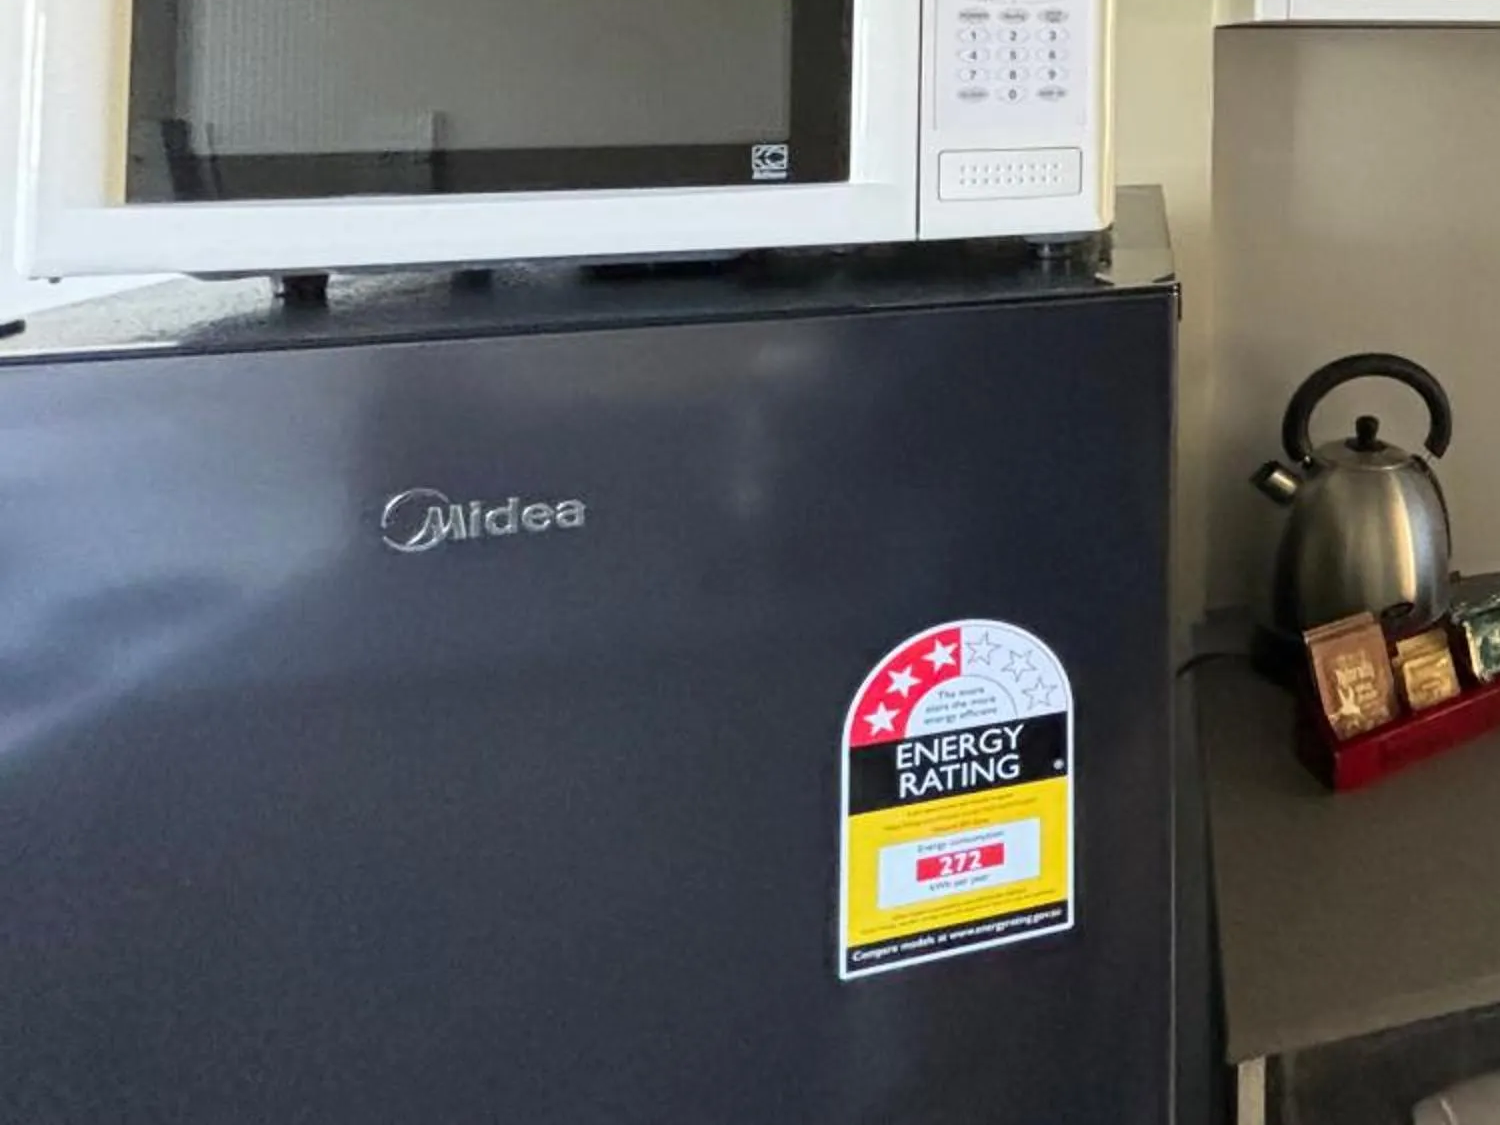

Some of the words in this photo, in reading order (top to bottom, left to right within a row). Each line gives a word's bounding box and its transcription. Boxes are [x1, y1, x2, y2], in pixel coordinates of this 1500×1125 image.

[1009, 30, 1017, 42] 2
[1048, 29, 1057, 42] 3
[969, 50, 977, 61] 4
[969, 69, 977, 81] 7
[1008, 88, 1017, 100] 0
[381, 487, 586, 552] Midea
[938, 690, 956, 700] The
[959, 686, 985, 696] more
[896, 724, 1025, 771] ENERGY
[899, 754, 1021, 799] RATING
[917, 842, 948, 854] Energy
[938, 849, 983, 876] 272
[852, 944, 898, 962] Compare
[900, 936, 935, 951] models
